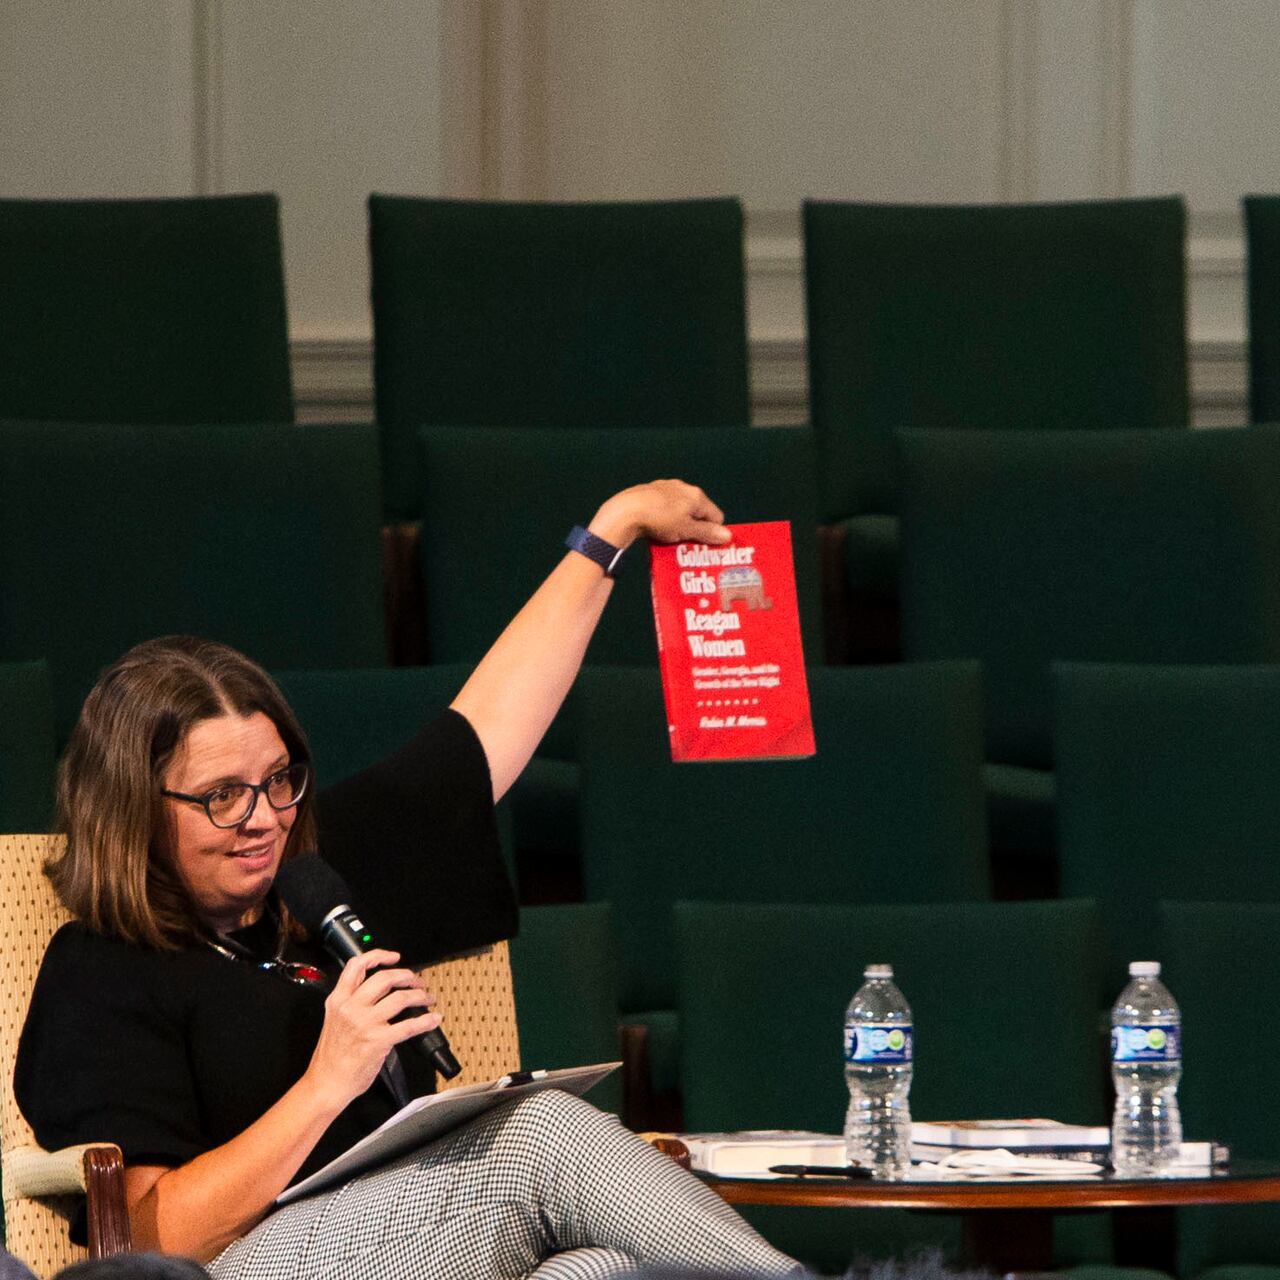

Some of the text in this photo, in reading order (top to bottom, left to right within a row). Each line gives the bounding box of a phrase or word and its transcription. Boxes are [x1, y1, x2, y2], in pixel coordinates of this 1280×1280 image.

[677, 544, 755, 567] Goldwater
[680, 570, 717, 594] Girls
[685, 608, 741, 636] Reagan
[688, 635, 746, 657] Women
